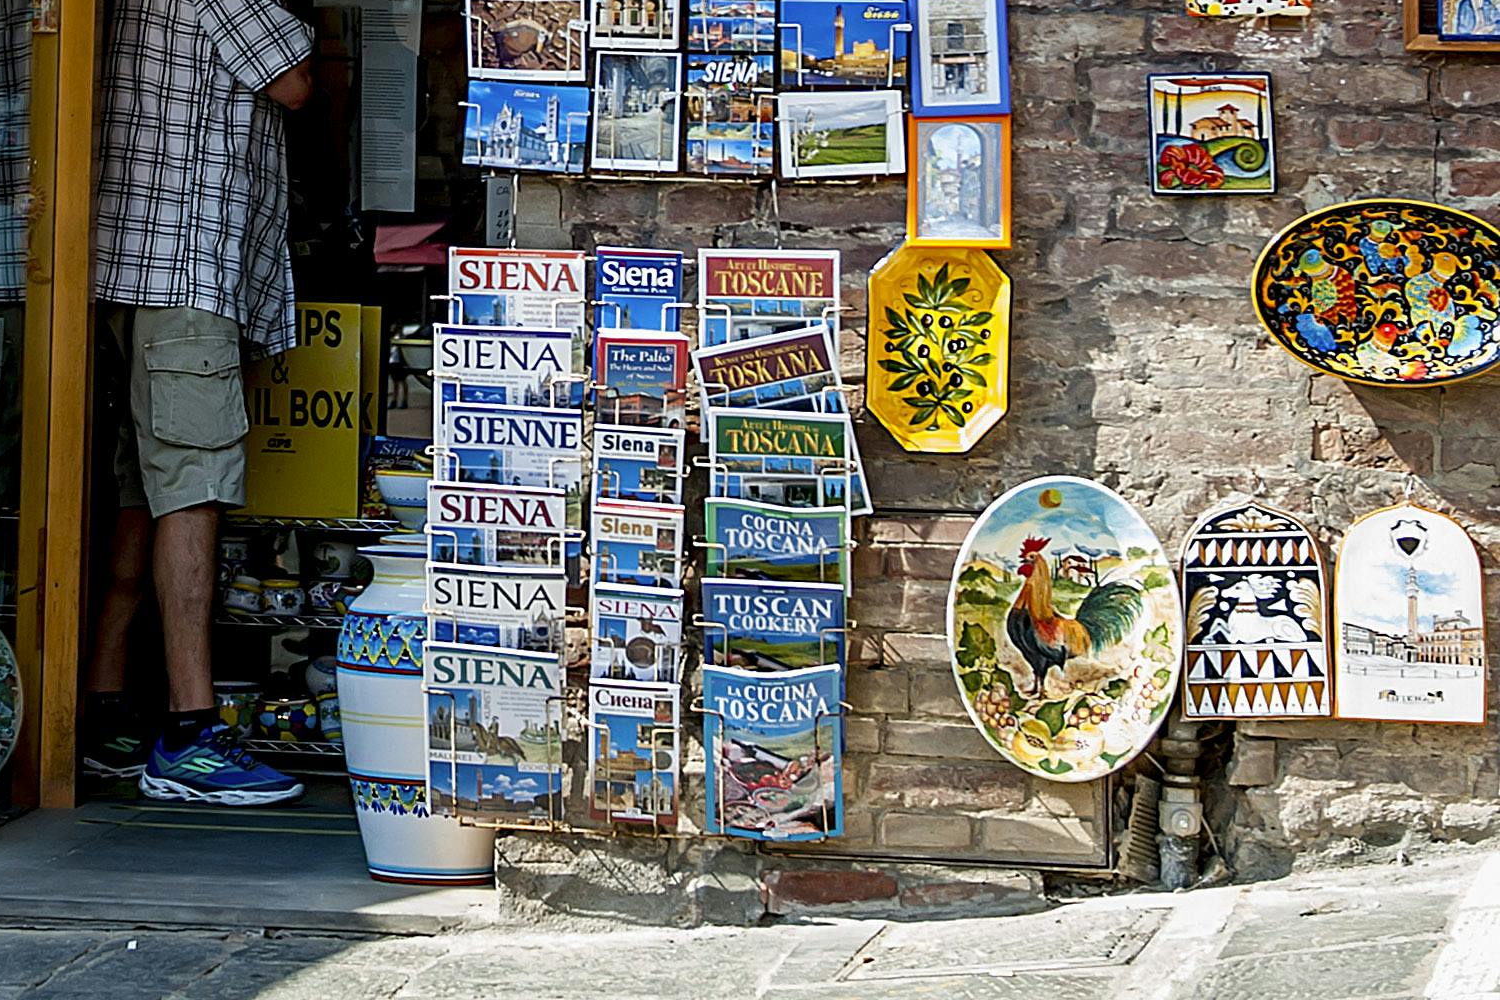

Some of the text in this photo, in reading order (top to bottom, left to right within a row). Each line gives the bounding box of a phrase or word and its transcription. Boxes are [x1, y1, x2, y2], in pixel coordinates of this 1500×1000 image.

[702, 61, 759, 84] SIENA
[459, 259, 579, 292] SIENA
[602, 260, 674, 288] Siena
[713, 270, 824, 297] TOSCANE
[440, 338, 563, 372] SIENA
[611, 348, 671, 363] The Palio
[708, 349, 825, 388] TOSKANA
[289, 389, 354, 429] BOX
[266, 438, 292, 448] GPS
[453, 415, 578, 450] SIENNE
[602, 434, 655, 453] Siena
[724, 429, 836, 456] TOSCANA
[379, 442, 414, 457] Sien
[440, 493, 556, 528] SIENA
[600, 516, 653, 537] Siena
[741, 514, 813, 537] COCINA
[725, 528, 831, 555] TOSCANA
[433, 577, 557, 611] SIENA
[713, 593, 833, 620] TUSCAN
[599, 599, 678, 619] SIENA
[728, 614, 820, 634] COOKERY
[433, 655, 556, 690] SIENA
[727, 682, 818, 703] LA CUCINA
[714, 696, 831, 724] TOSCANA
